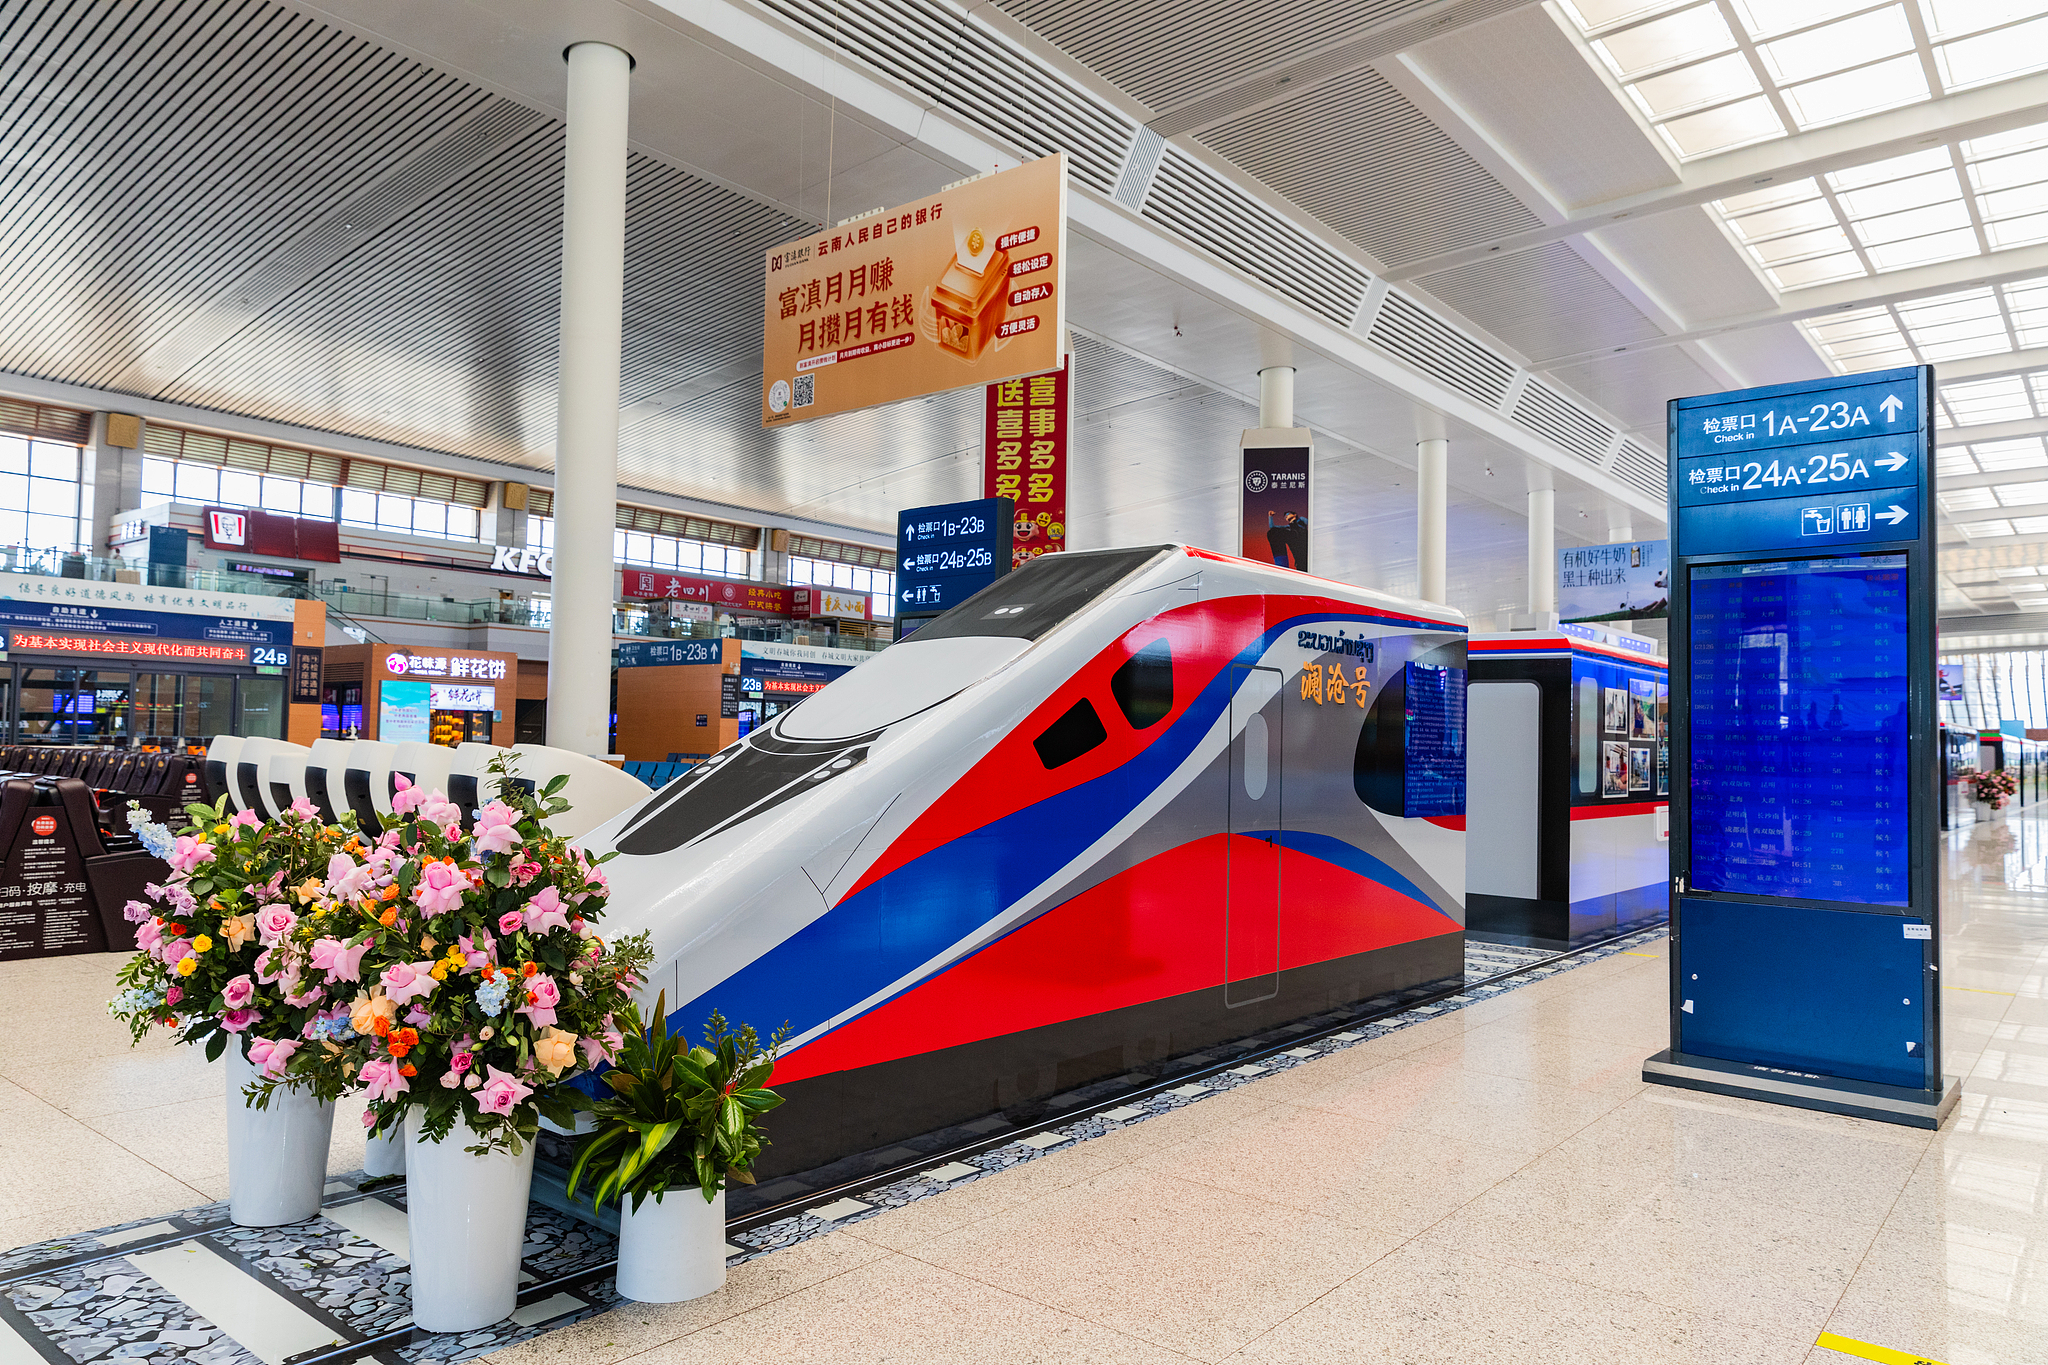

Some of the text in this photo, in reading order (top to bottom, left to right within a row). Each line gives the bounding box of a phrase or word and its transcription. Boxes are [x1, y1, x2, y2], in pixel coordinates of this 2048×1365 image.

[818, 203, 943, 257] 云南人民自己的银行
[1001, 229, 1035, 248] 操作便捷
[1013, 256, 1048, 275] 轻松设定
[779, 257, 894, 320] 富滇月月赚
[1014, 286, 1048, 304] 自动存入
[798, 294, 914, 354] 月攒月有钱
[1001, 318, 1035, 336] 方便灵活
[1703, 401, 1870, 437] 检票口 1A-23A
[996, 379, 1024, 502] 送喜多多
[1029, 377, 1056, 502] 喜事多多
[1714, 431, 1754, 443] Check in
[1689, 466, 1741, 485] 检票口
[1700, 483, 1739, 495] Check in
[918, 516, 985, 536] 检票口 1B-23B
[490, 545, 553, 577] KFC
[917, 553, 939, 565] 检票口
[1563, 547, 1626, 568] 有机好牛奶
[1563, 567, 1626, 588] 黑土种出来
[19, 583, 135, 602] 倡导良好道德风尚
[665, 577, 709, 602] 老四川
[748, 588, 782, 600] 经典小吃
[821, 595, 865, 613] 重庆小面
[13, 634, 247, 660] 为基本实现社会主义现代化而共同奋斗
[252, 647, 287, 665] 24B
[670, 643, 707, 661] 1B-23B
[763, 647, 816, 659] 文明春城你我同创
[450, 657, 506, 679] 鲜花饼
[742, 678, 762, 691] 23B
[1301, 661, 1371, 708] 澜沧号
